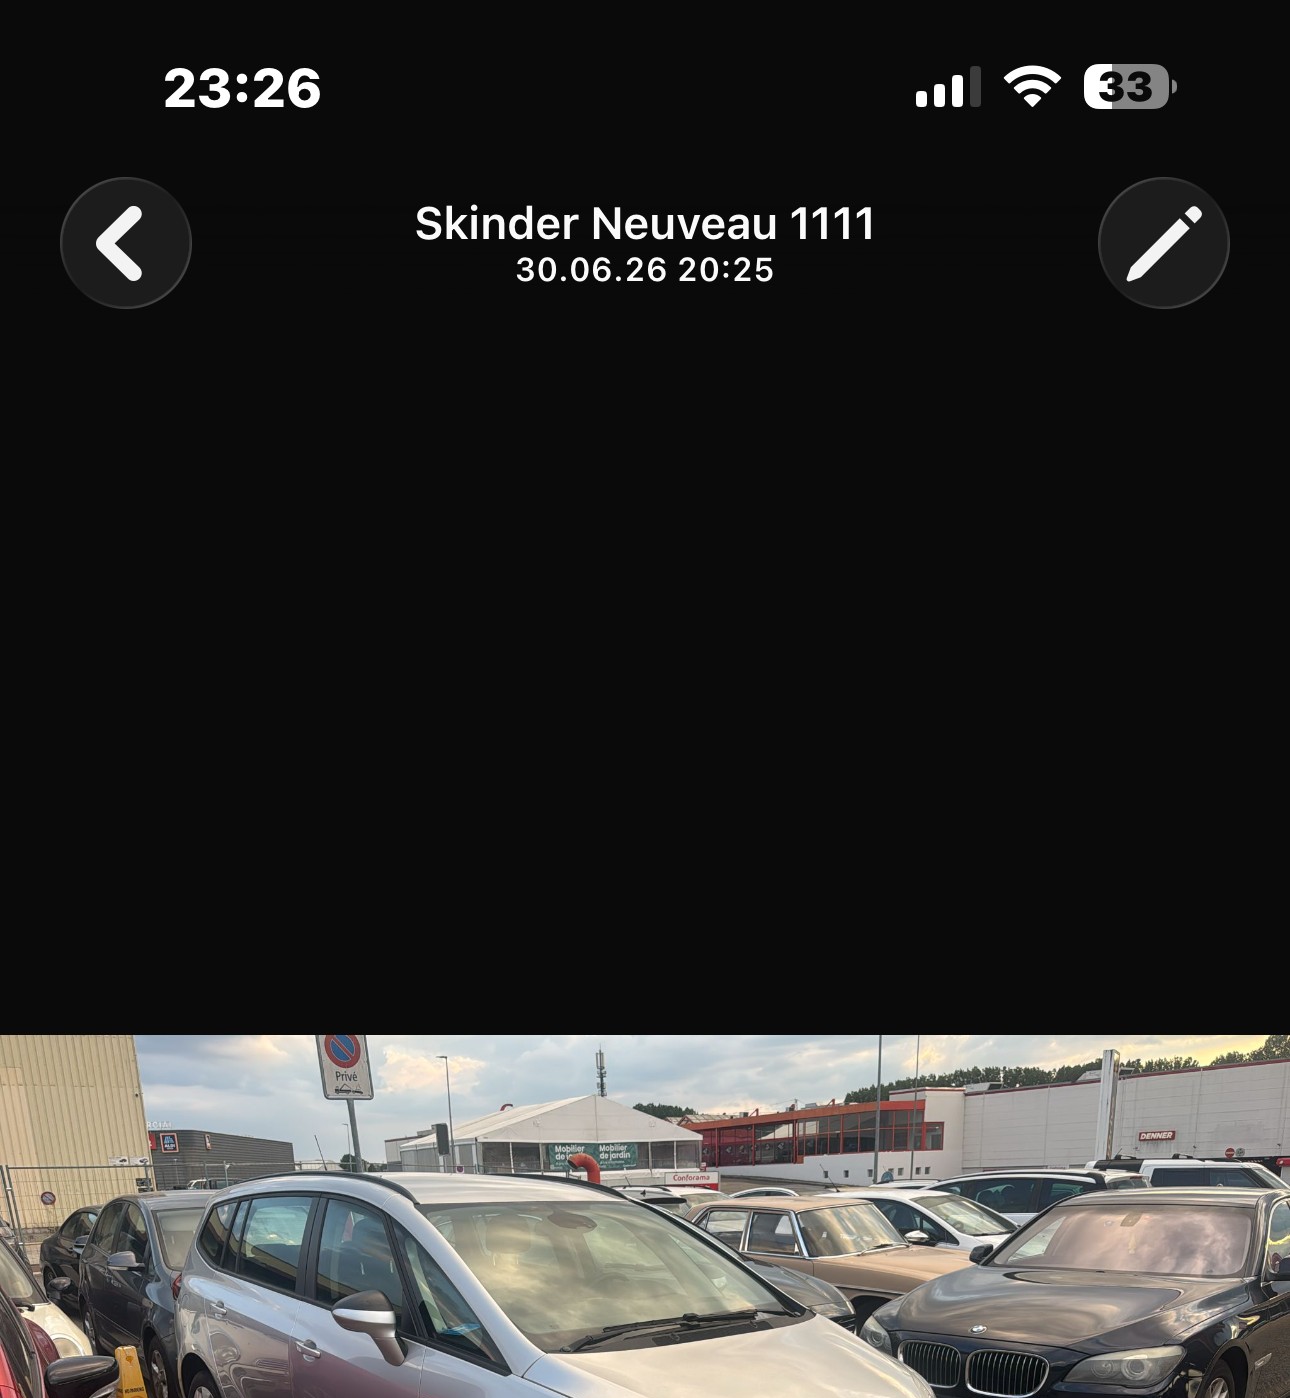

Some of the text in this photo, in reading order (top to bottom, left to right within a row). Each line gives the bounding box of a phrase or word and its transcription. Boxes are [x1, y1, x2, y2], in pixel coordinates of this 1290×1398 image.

[335, 1071, 358, 1081] Privé
[1140, 1131, 1173, 1140] DENNER
[599, 1144, 628, 1152] Mobilier
[555, 1152, 565, 1160] de
[609, 1150, 631, 1161] jardin
